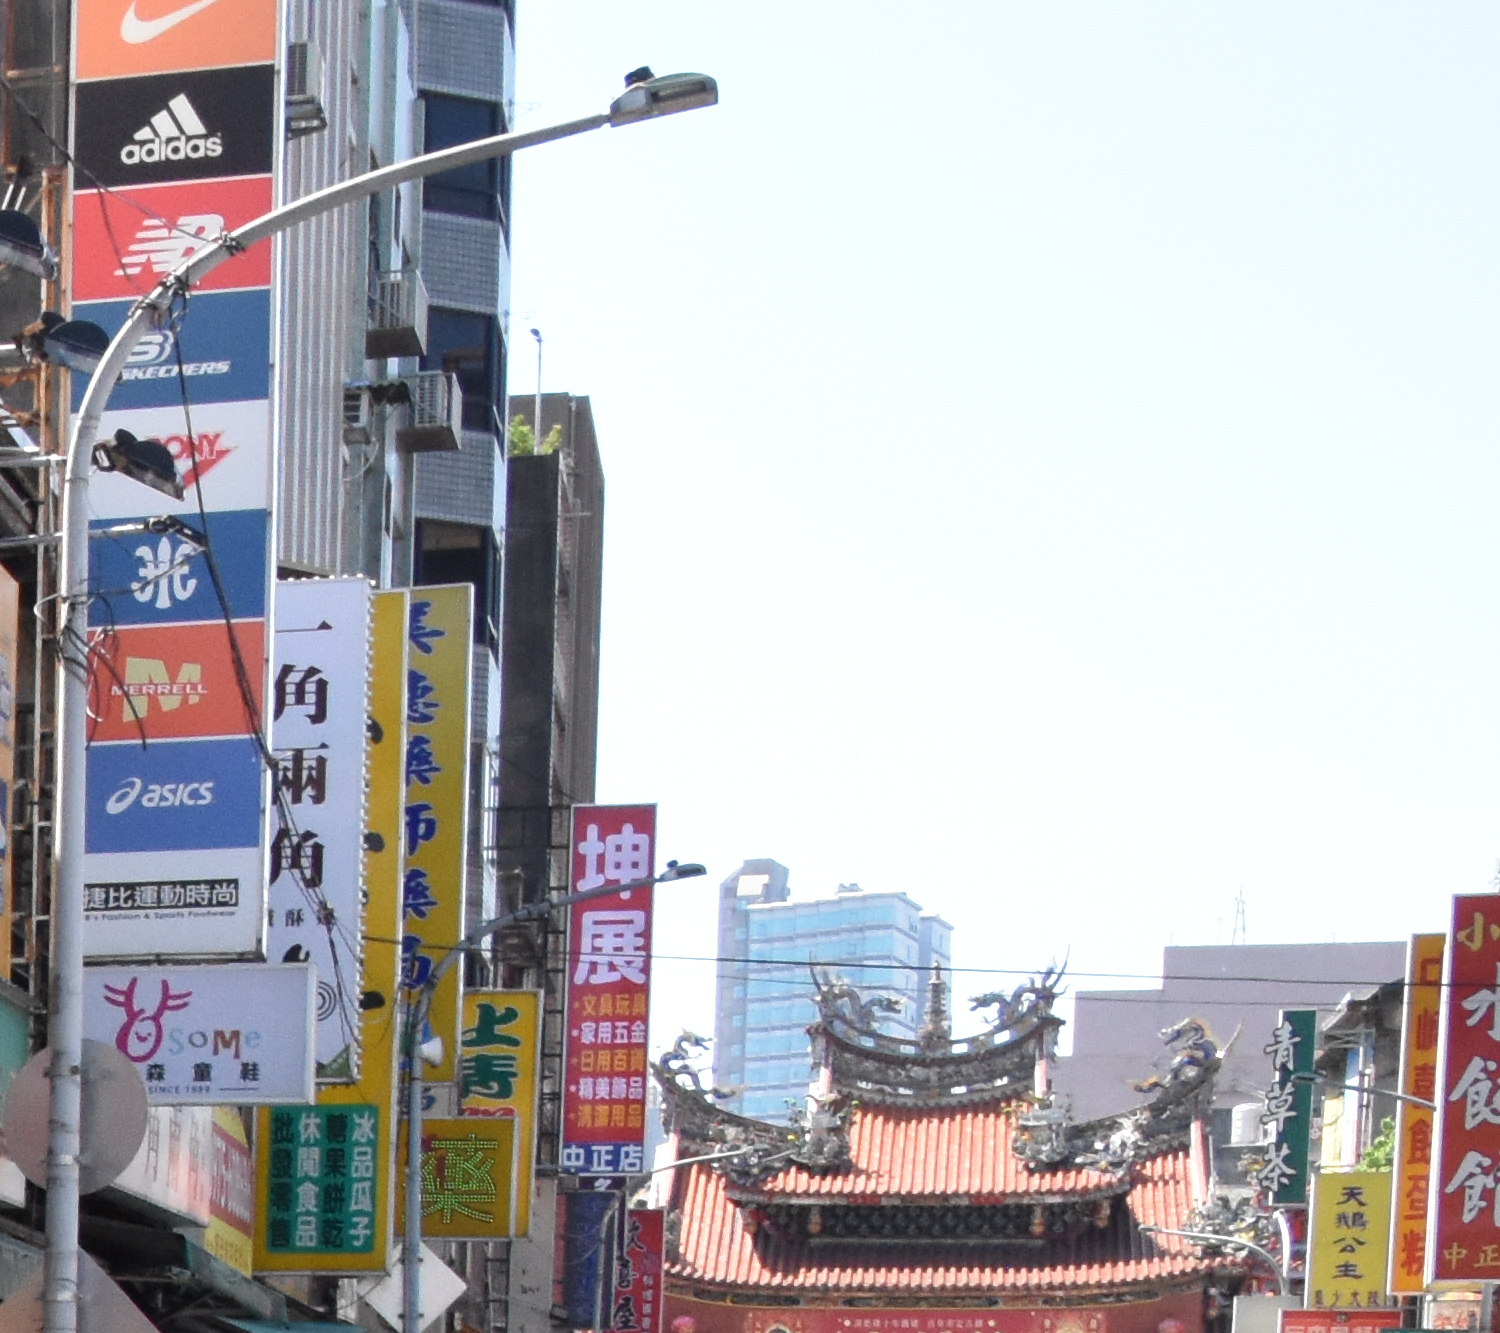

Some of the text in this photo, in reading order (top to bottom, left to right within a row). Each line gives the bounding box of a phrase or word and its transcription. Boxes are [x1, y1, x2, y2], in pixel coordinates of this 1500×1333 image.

[121, 132, 223, 165] adidas
[112, 683, 207, 696] MERRELL
[270, 619, 332, 889] 一角兩角
[142, 781, 214, 807] asics
[573, 823, 649, 985] 坤展
[580, 1048, 644, 1073] 日用百貨
[581, 1020, 646, 1044] 家用五金
[1258, 1021, 1302, 1192] 青草茶
[296, 1112, 320, 1247] 休閒食品
[349, 1112, 375, 1246] 冰品瓜子
[562, 1145, 644, 1172] 中正店
[1332, 1185, 1367, 1280] 天鵝公主
